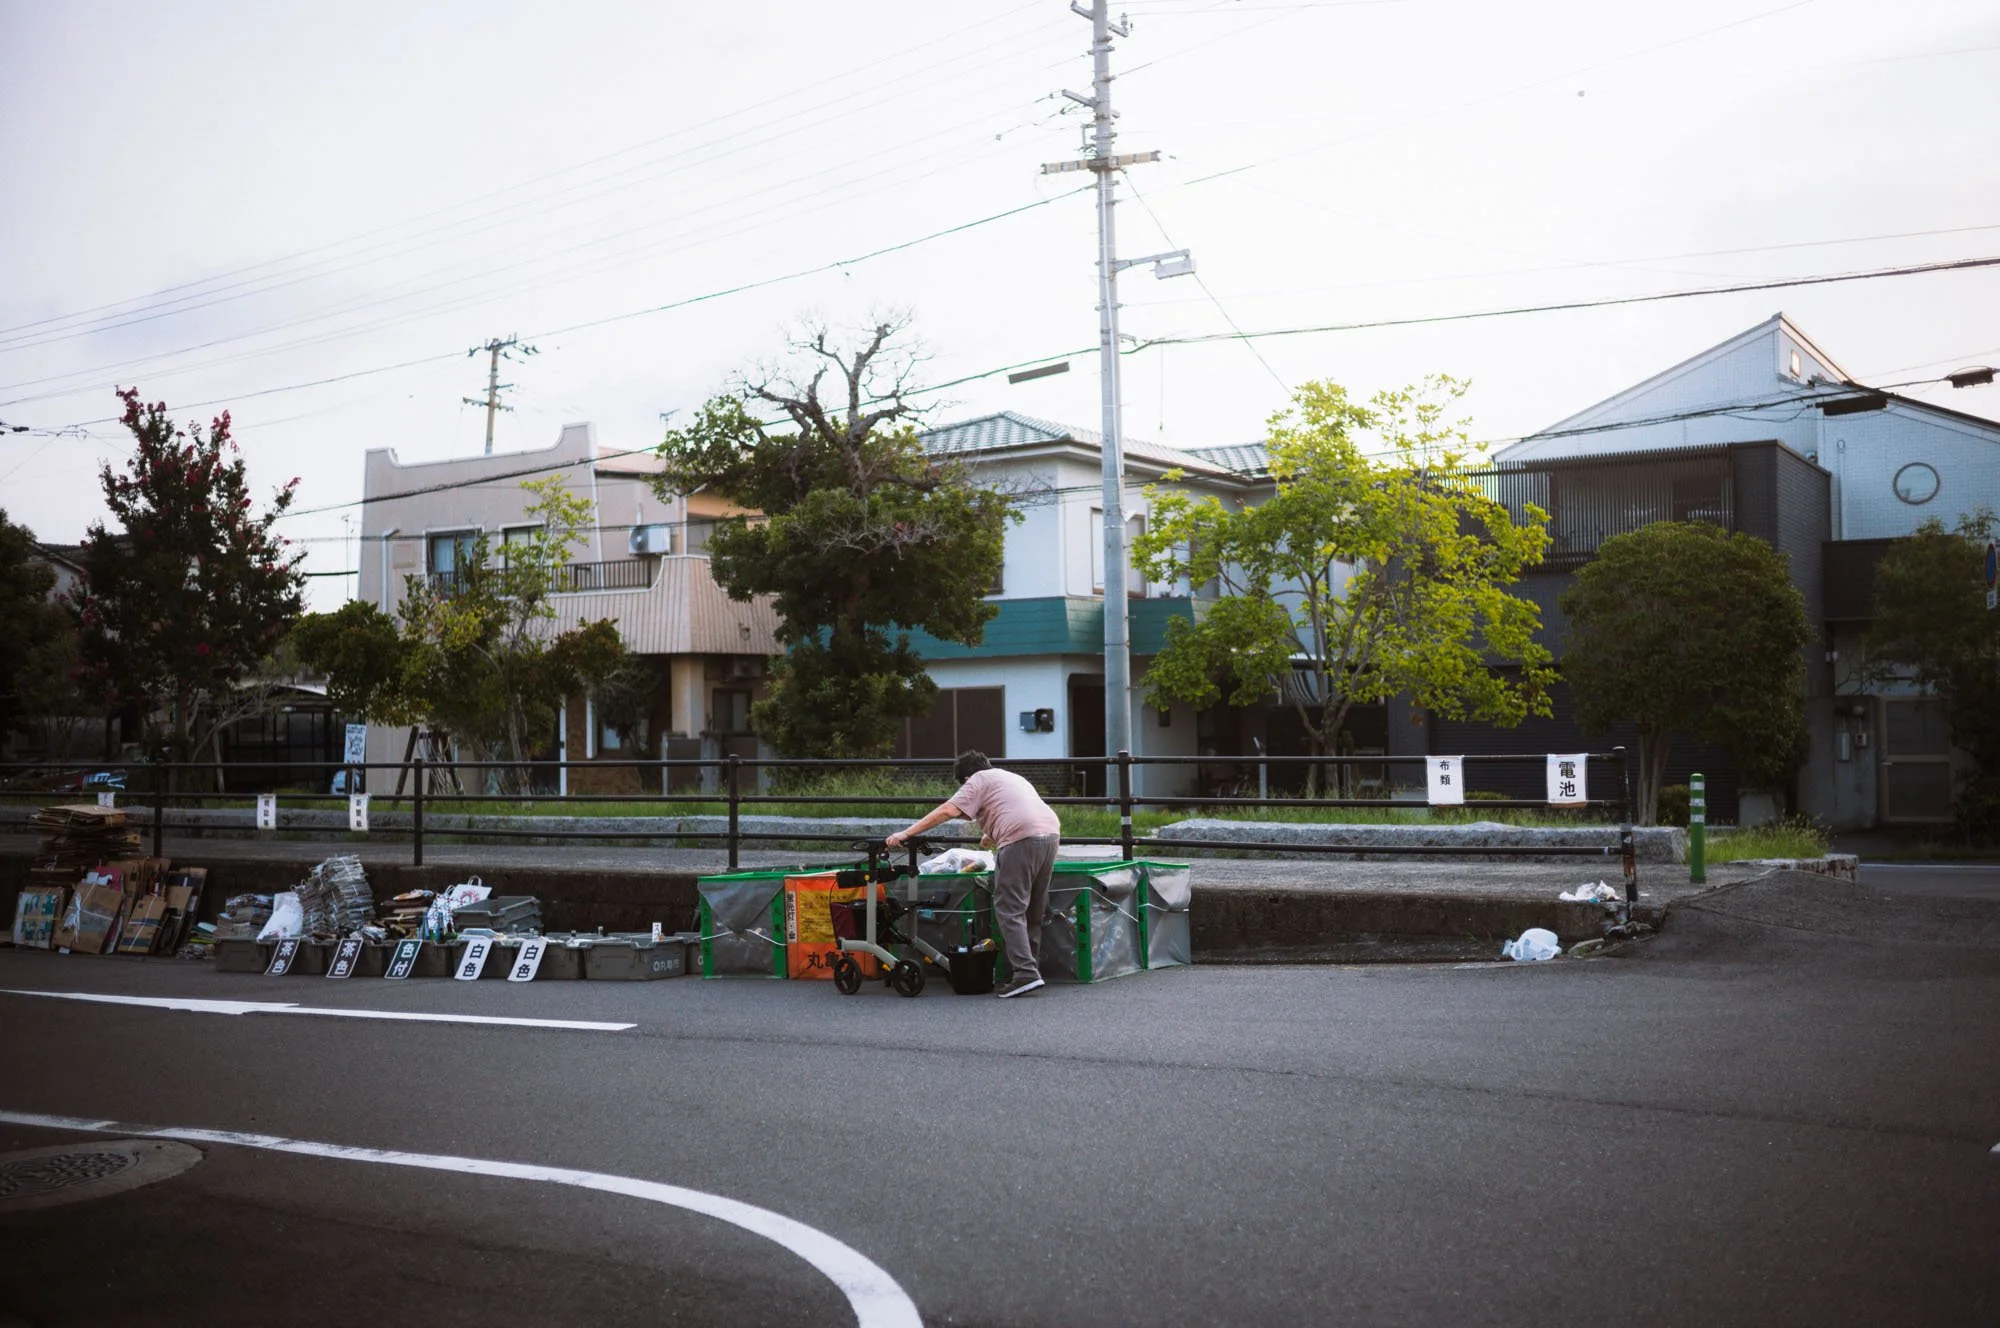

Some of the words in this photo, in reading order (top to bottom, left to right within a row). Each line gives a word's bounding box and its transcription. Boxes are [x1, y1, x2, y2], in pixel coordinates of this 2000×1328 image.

[1439, 760, 1451, 786] 布類
[1558, 761, 1577, 797] 電池
[272, 942, 294, 974] 茶色
[334, 942, 356, 975] 茶色
[392, 943, 415, 976] 色付
[463, 944, 485, 977] 白色
[516, 945, 539, 978] 白色
